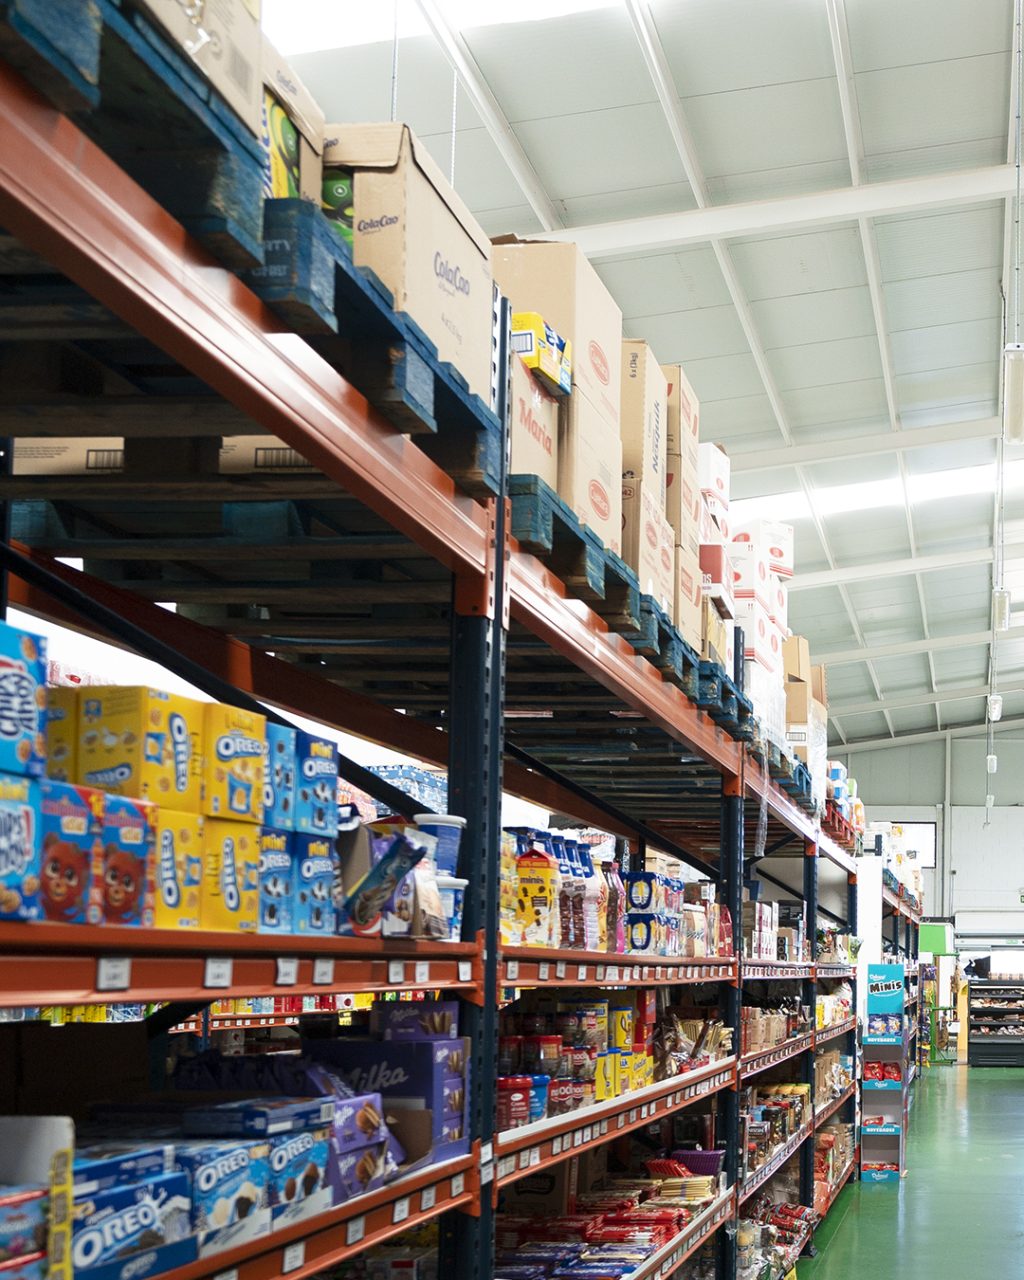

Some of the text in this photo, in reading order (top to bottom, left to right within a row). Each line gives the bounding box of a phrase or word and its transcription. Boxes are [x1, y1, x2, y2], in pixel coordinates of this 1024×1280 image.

[358, 215, 398, 232] ColaCao
[433, 251, 470, 296] ColaCao
[869, 981, 902, 994] Minis
[199, 1150, 249, 1191] OREO
[272, 1133, 313, 1171] OREO
[73, 1204, 152, 1268] OREO
